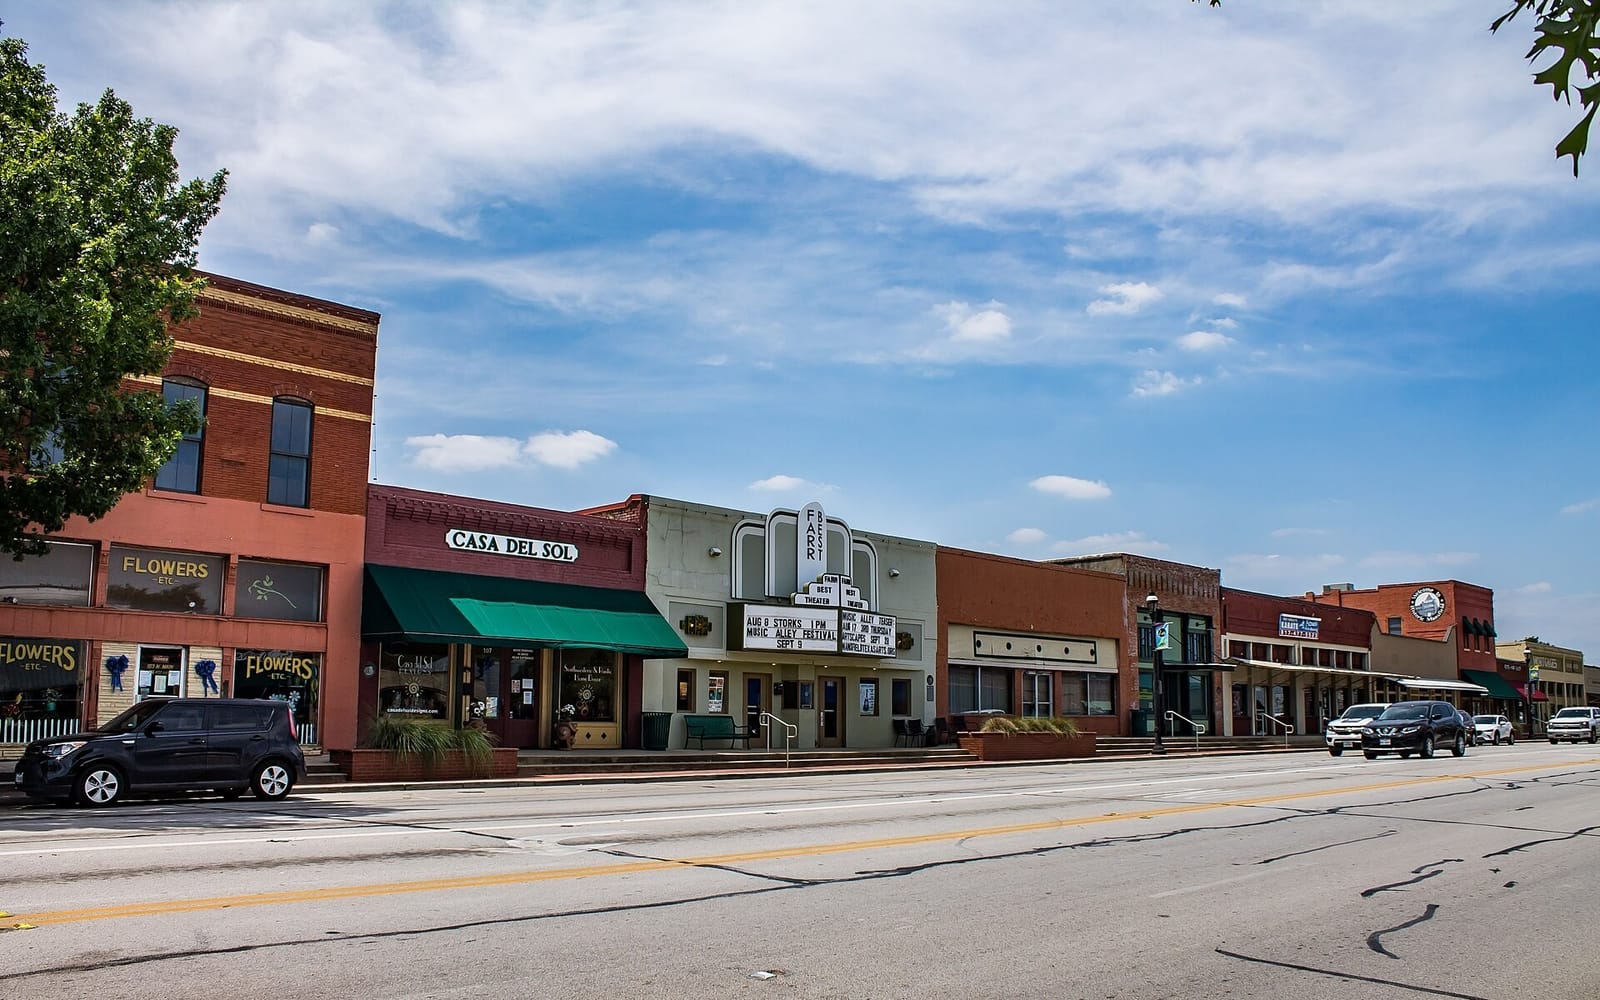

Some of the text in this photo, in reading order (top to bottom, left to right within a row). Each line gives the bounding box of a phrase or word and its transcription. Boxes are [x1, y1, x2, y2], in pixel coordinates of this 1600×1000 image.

[806, 509, 816, 561] FARR
[453, 531, 573, 560] CASA DEL SOL
[123, 556, 209, 578] FLOWERS
[805, 596, 830, 604] THEATER
[847, 600, 863, 608] THEATER
[747, 617, 761, 627] AUG
[764, 617, 769, 627] 8
[774, 618, 802, 628] STORKS
[842, 613, 856, 622] MUSIC
[861, 614, 874, 624] ALLEY
[747, 628, 836, 640] MUSIC ALLEY FESTIVAL
[842, 622, 851, 631] AUG
[852, 623, 857, 632] 17
[870, 626, 892, 636] THURSDAY
[777, 640, 802, 648] SEPT 9
[842, 632, 866, 643] ARTSCAPES
[870, 635, 880, 644] SEPT
[0, 642, 75, 671] FLOWERS
[25, 663, 42, 671] ETC
[246, 655, 313, 679] FLOWERS
[271, 672, 287, 680] ETC
